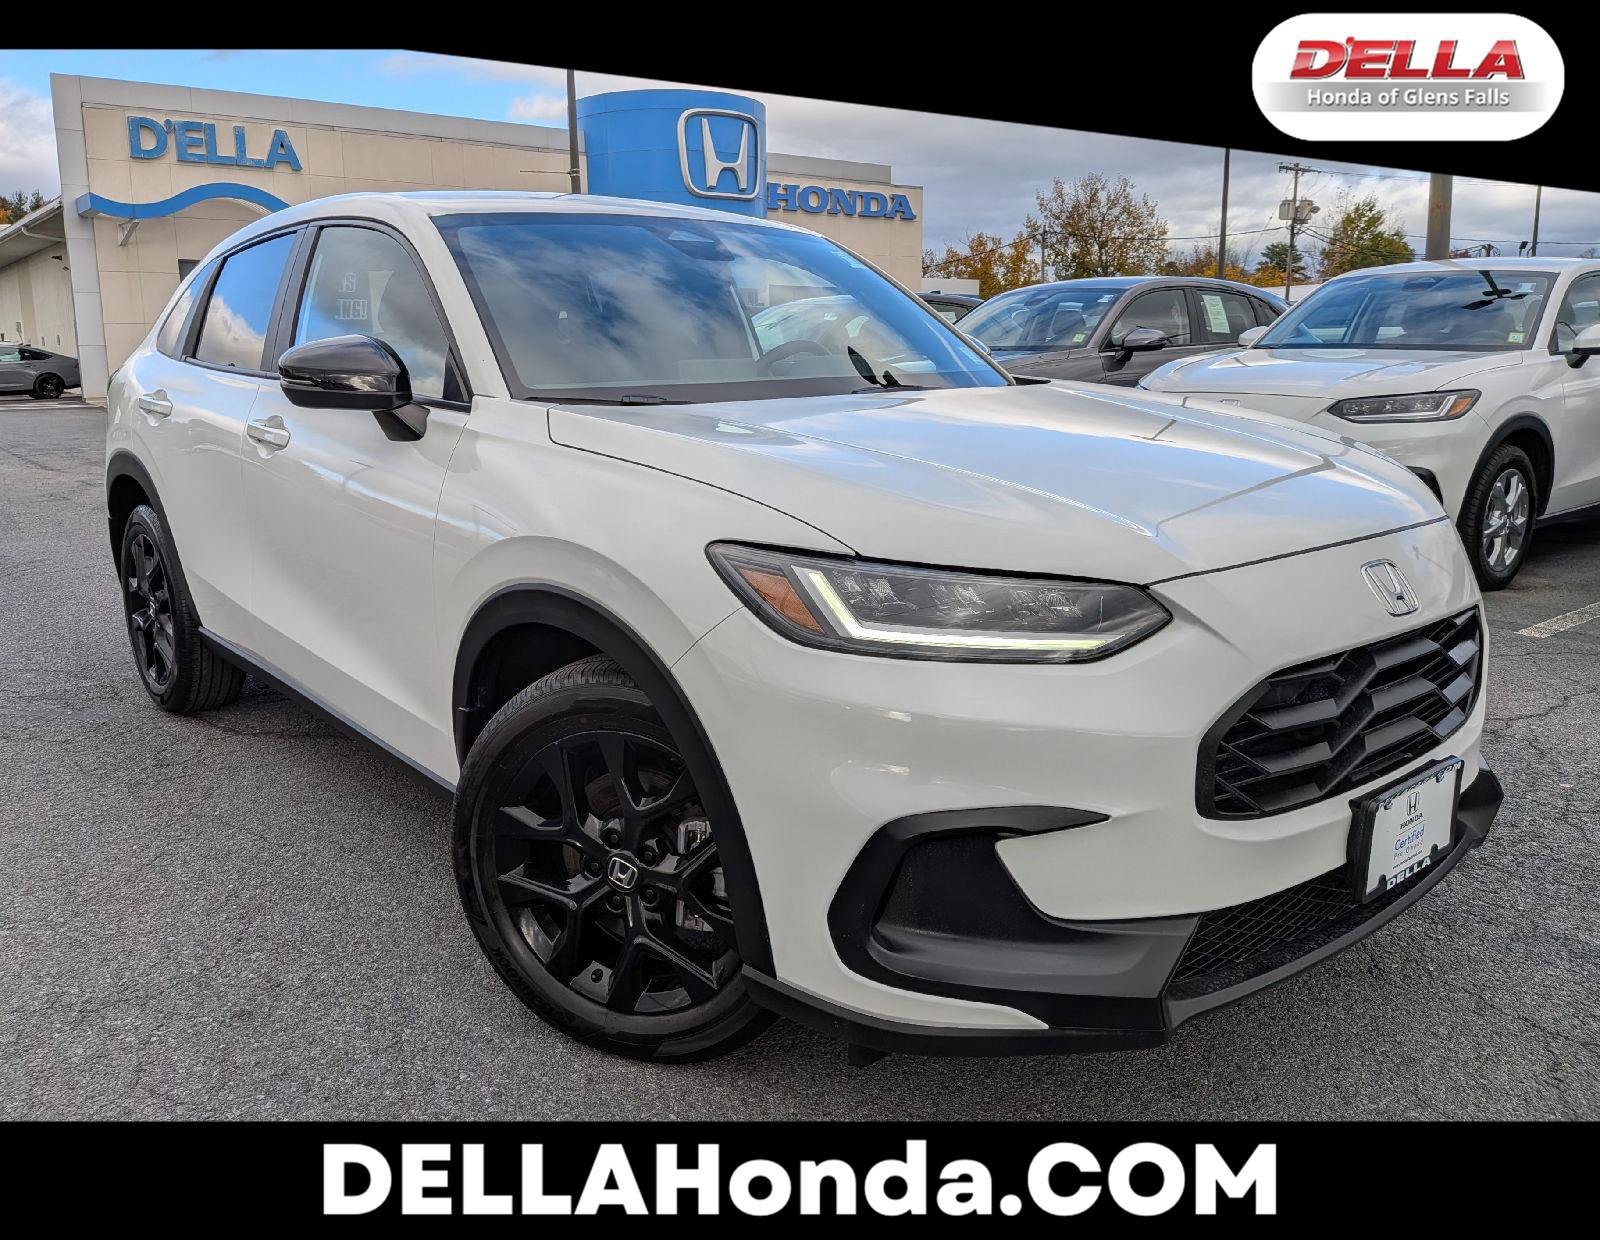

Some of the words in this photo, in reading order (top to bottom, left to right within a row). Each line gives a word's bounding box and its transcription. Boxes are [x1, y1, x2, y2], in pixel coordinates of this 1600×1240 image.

[127, 116, 303, 172] D'ELLA
[767, 182, 917, 220] HONDA
[1399, 812, 1424, 829] HONDA
[1395, 825, 1425, 851] Certified
